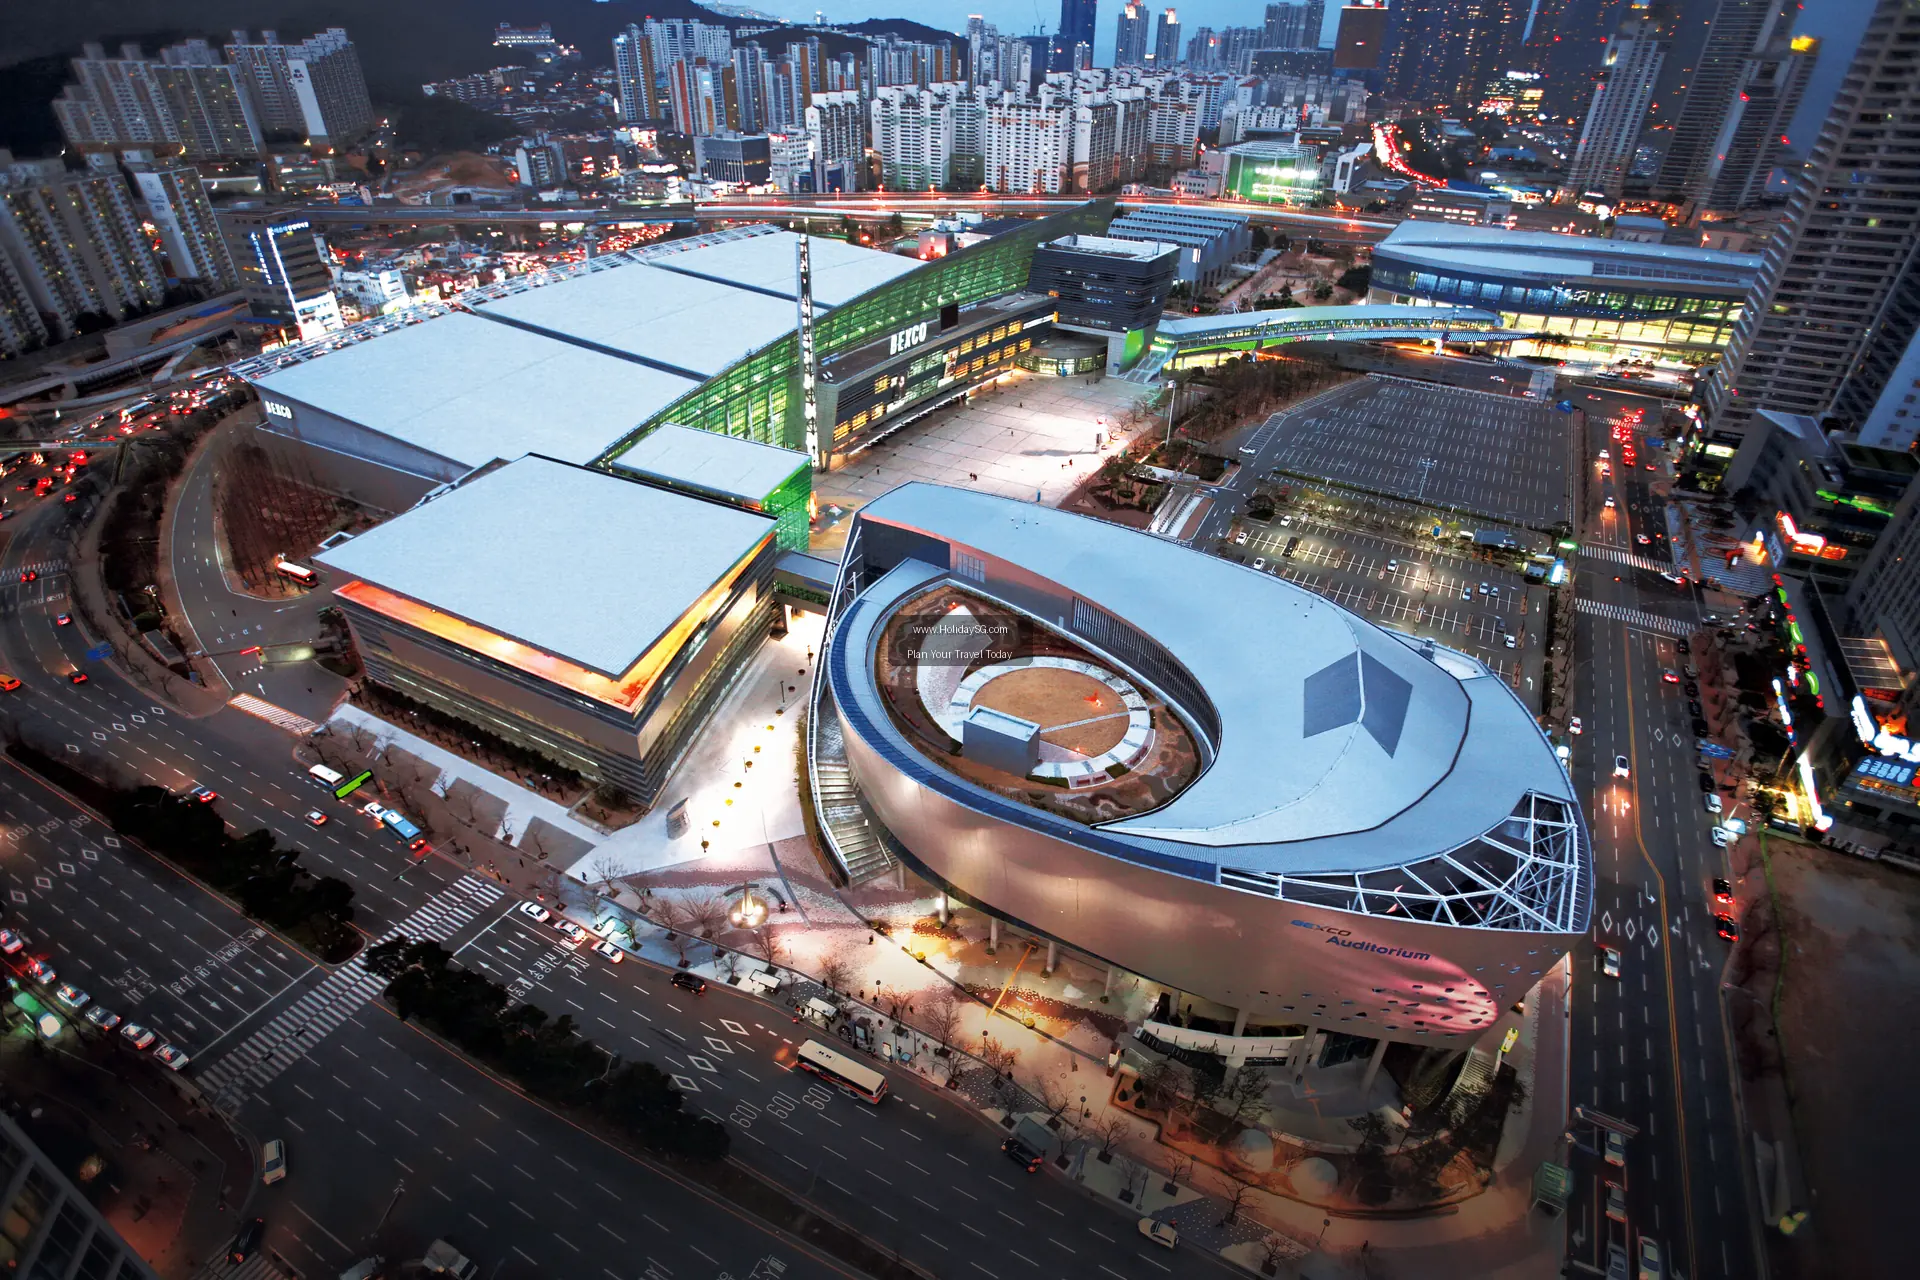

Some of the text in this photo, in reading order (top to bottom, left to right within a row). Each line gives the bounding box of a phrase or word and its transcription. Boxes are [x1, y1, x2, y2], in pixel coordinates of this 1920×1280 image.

[890, 322, 927, 355] BEXCO
[264, 400, 292, 419] BEXCO
[1290, 919, 1352, 936] BEXCO
[1325, 935, 1431, 961] Auditorium
